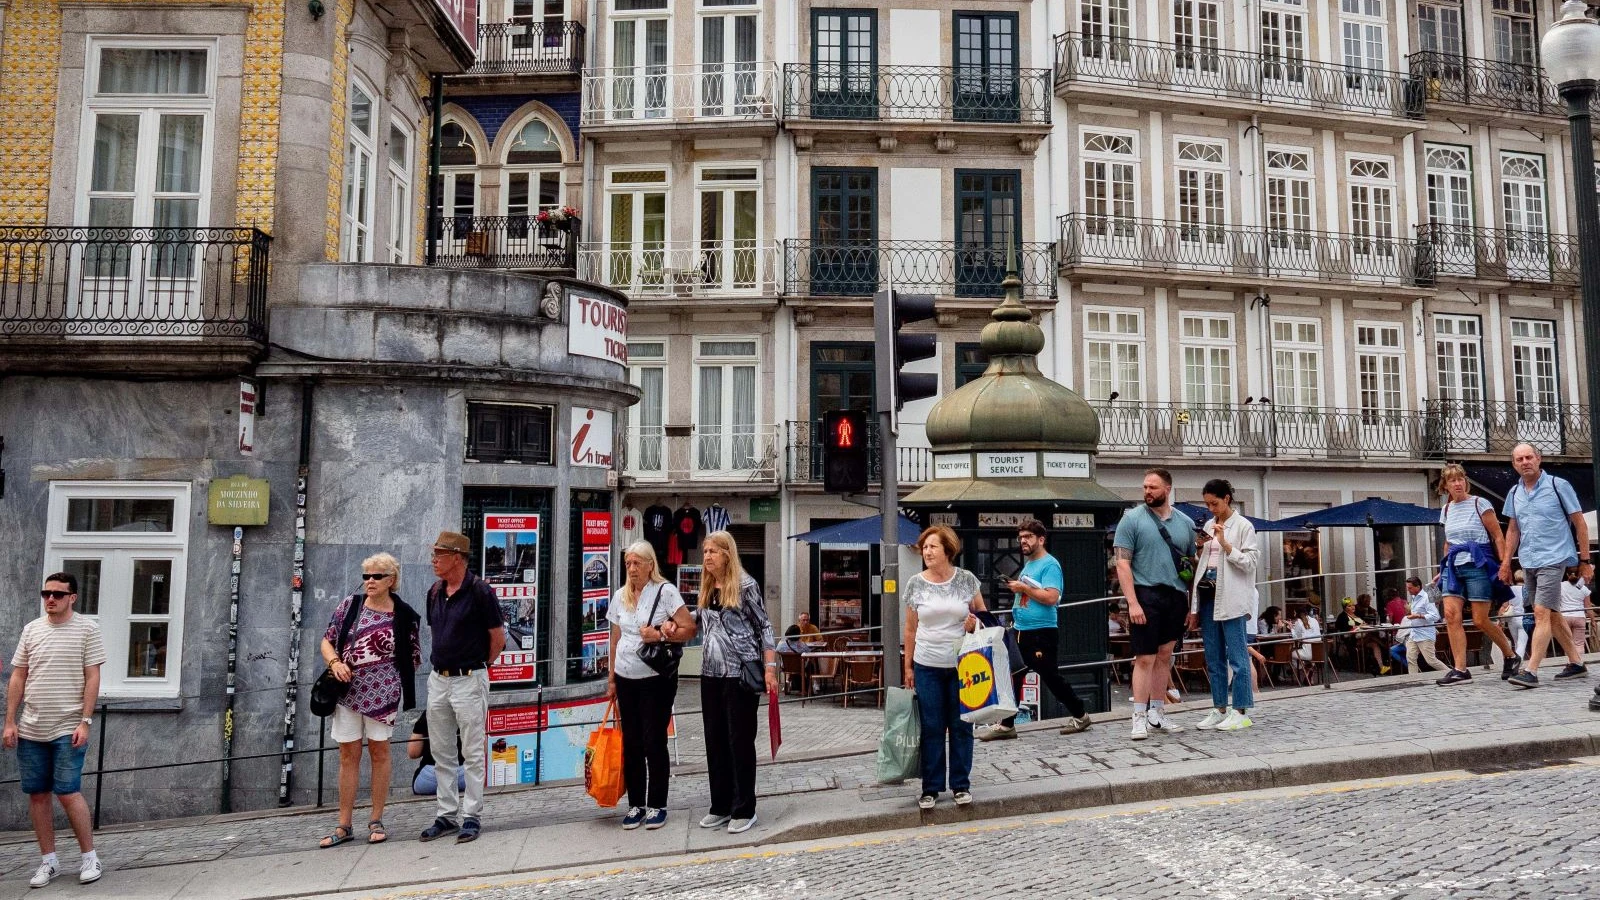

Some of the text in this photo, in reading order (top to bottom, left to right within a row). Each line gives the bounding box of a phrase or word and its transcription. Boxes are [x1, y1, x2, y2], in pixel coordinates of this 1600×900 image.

[578, 298, 627, 336] TOURIST
[595, 451, 612, 465] travel
[989, 456, 1024, 464] TOURIST
[991, 466, 1024, 474] SERVICE
